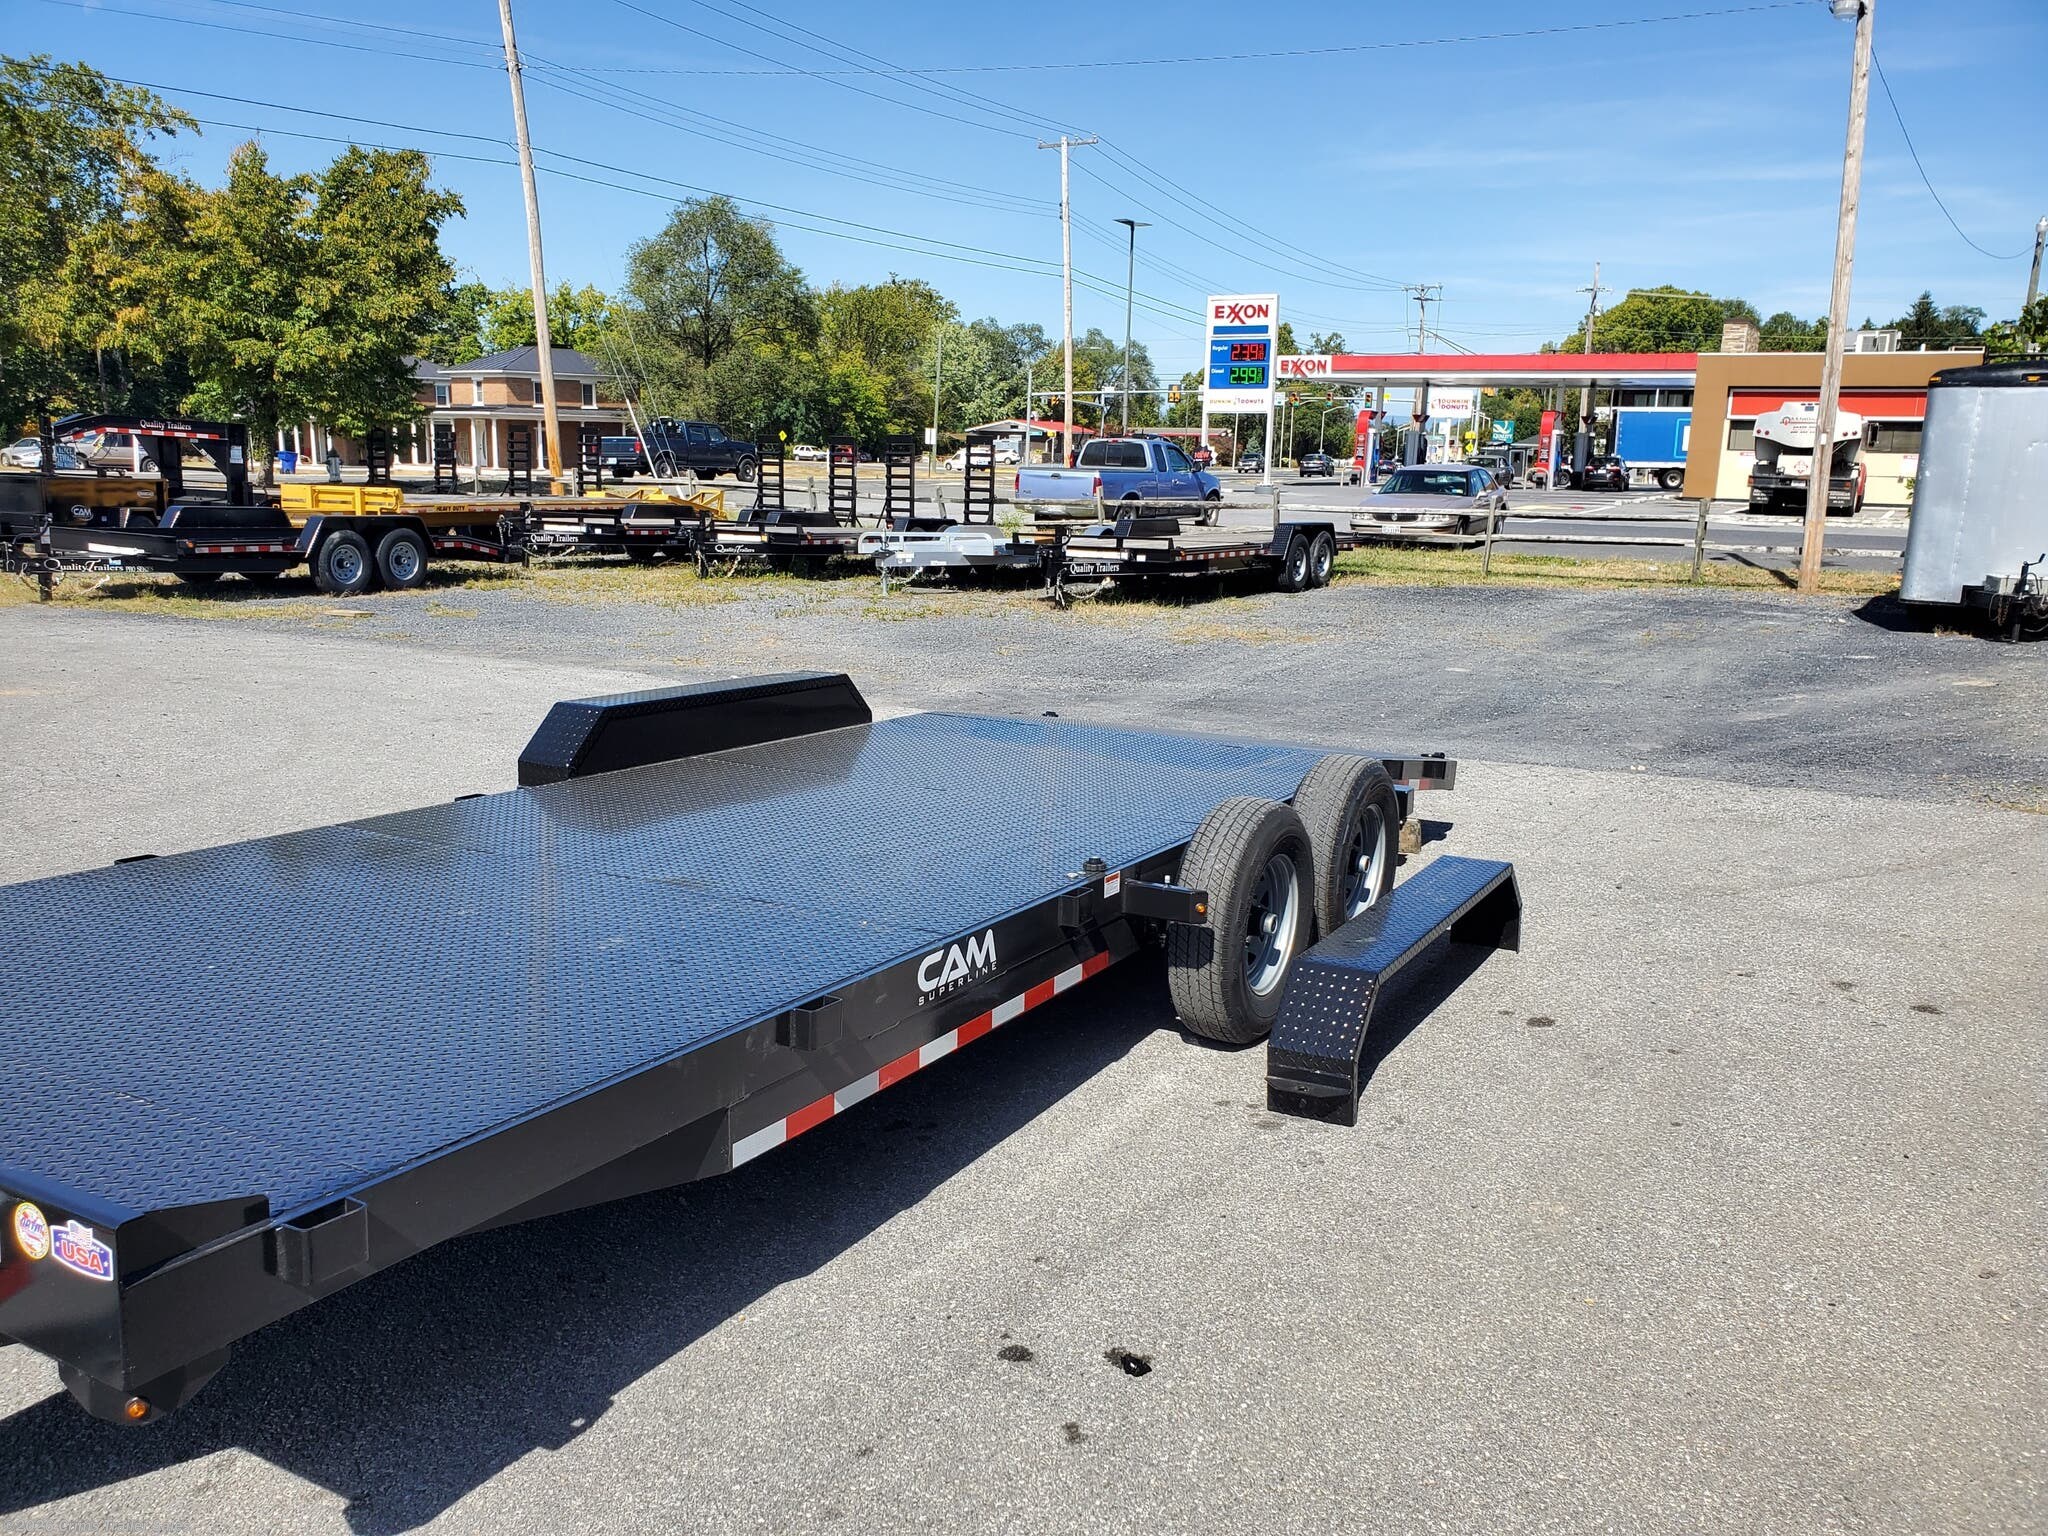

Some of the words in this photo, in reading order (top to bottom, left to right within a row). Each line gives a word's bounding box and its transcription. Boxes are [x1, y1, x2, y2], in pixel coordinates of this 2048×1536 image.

[1214, 303, 1269, 324] EXXON
[1281, 358, 1327, 378] EXXON
[140, 419, 165, 430] Quality
[167, 421, 192, 430] Trailers
[73, 507, 92, 518] CAM
[530, 533, 554, 545] Quality
[555, 534, 579, 543] Trailers
[43, 558, 88, 572] Quality
[85, 559, 124, 572] Trailers
[1070, 563, 1094, 575] Quality
[1096, 563, 1119, 573] Trailers
[917, 929, 997, 992] CAM
[918, 961, 997, 1006] SUPERLINE
[61, 1239, 104, 1274] USA
